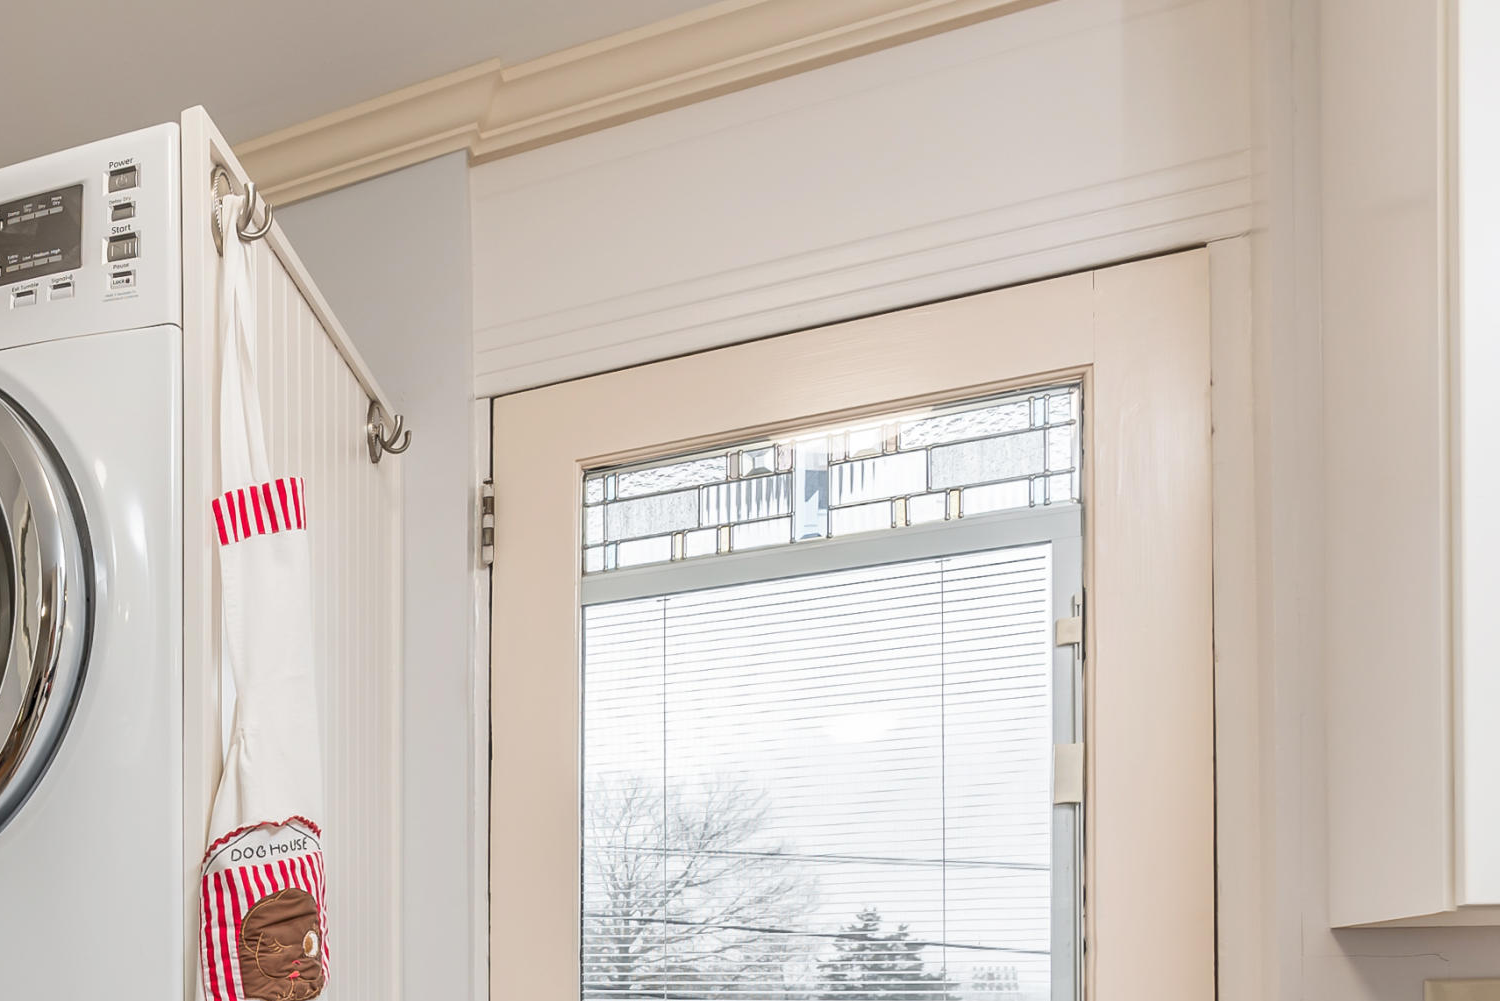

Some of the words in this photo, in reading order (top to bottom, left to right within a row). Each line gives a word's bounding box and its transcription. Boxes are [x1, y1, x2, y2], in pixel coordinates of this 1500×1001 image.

[109, 158, 133, 169] Power
[111, 224, 131, 235] Start
[113, 262, 130, 270] Pause
[20, 282, 39, 290] Tumble
[231, 845, 266, 862] DOG
